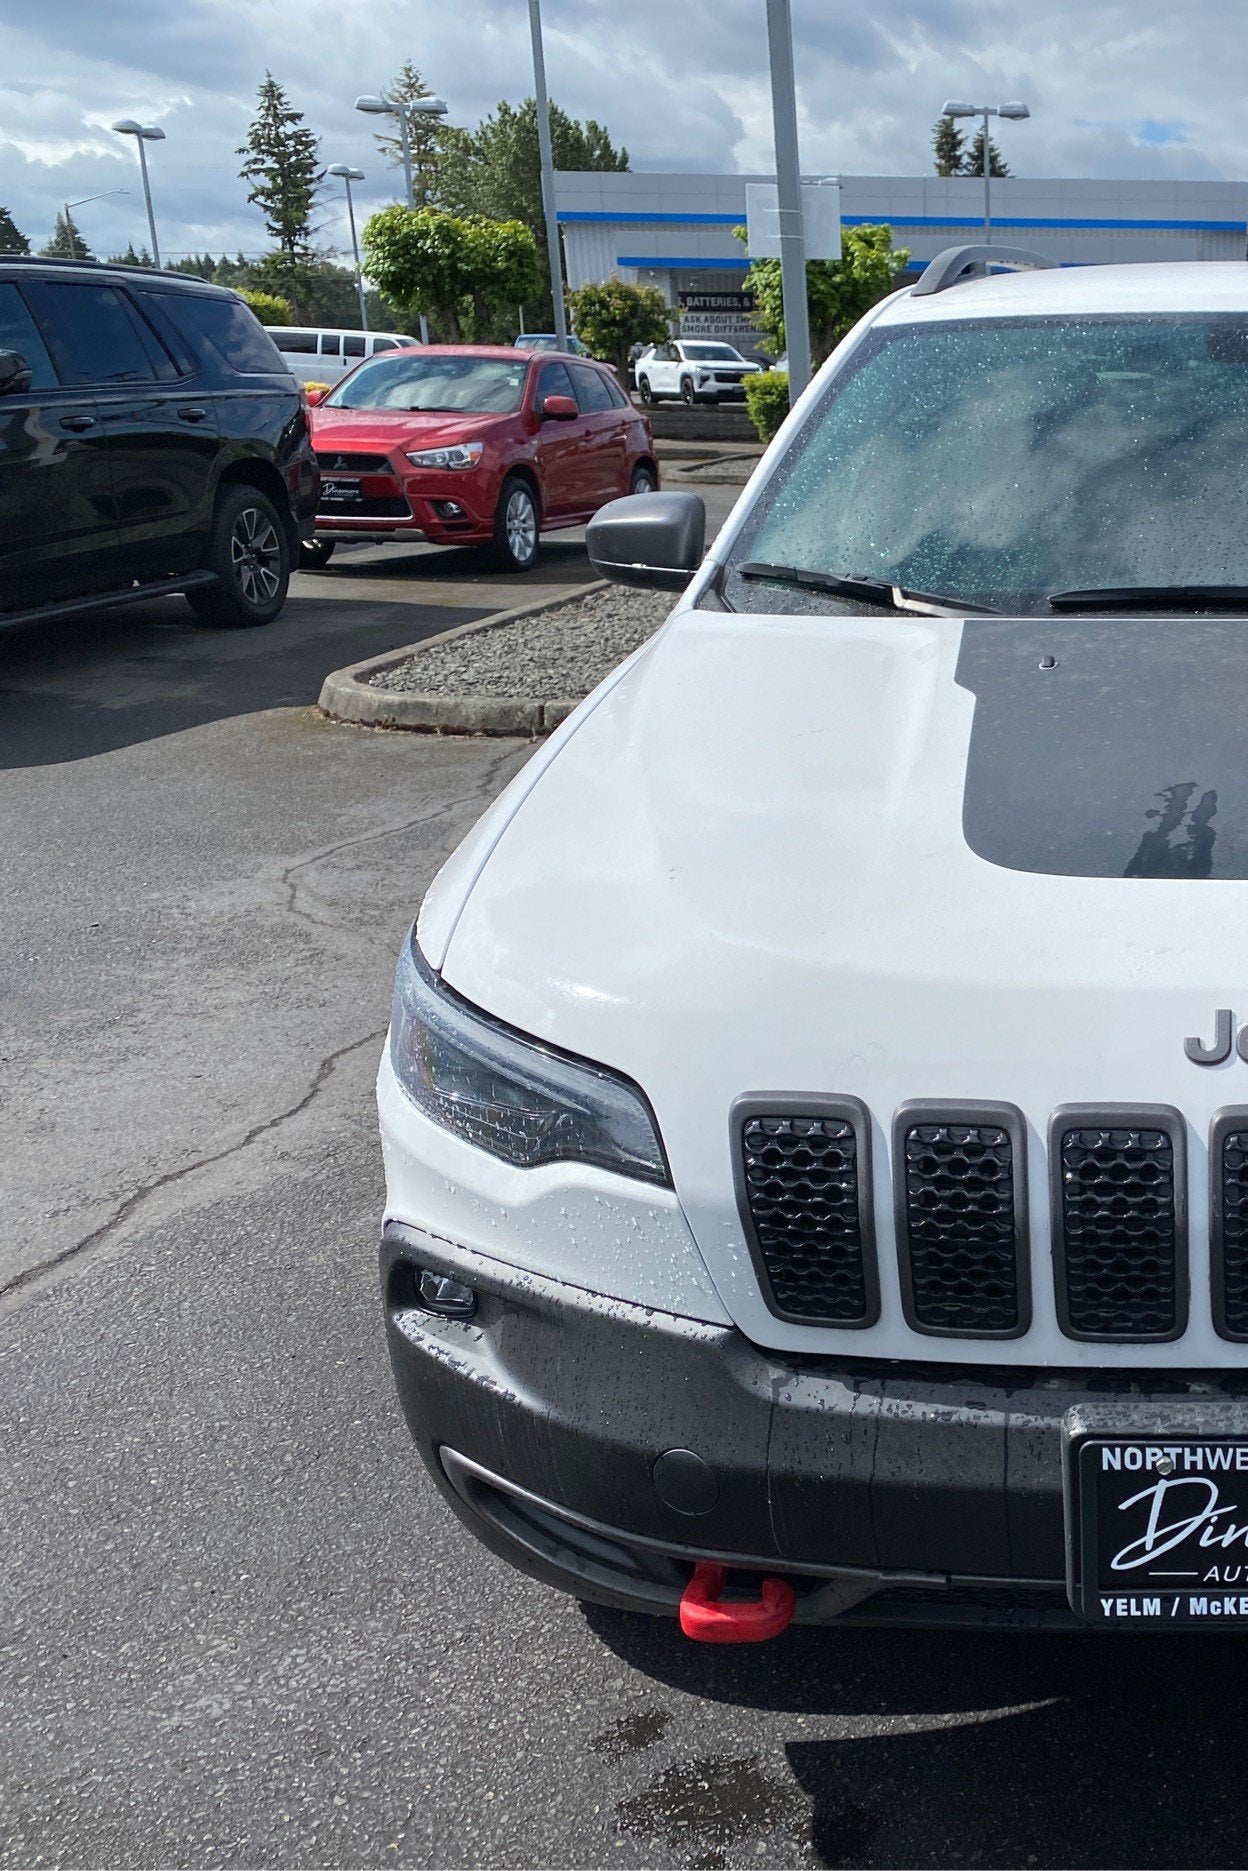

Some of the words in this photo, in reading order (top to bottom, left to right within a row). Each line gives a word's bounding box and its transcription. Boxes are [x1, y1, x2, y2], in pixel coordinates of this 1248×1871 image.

[704, 315, 733, 324] ABOUT
[682, 325, 712, 333] SMORE
[714, 325, 759, 333] DIFFEREN
[1100, 1598, 1161, 1616] YELM
[1171, 1597, 1179, 1616] /
